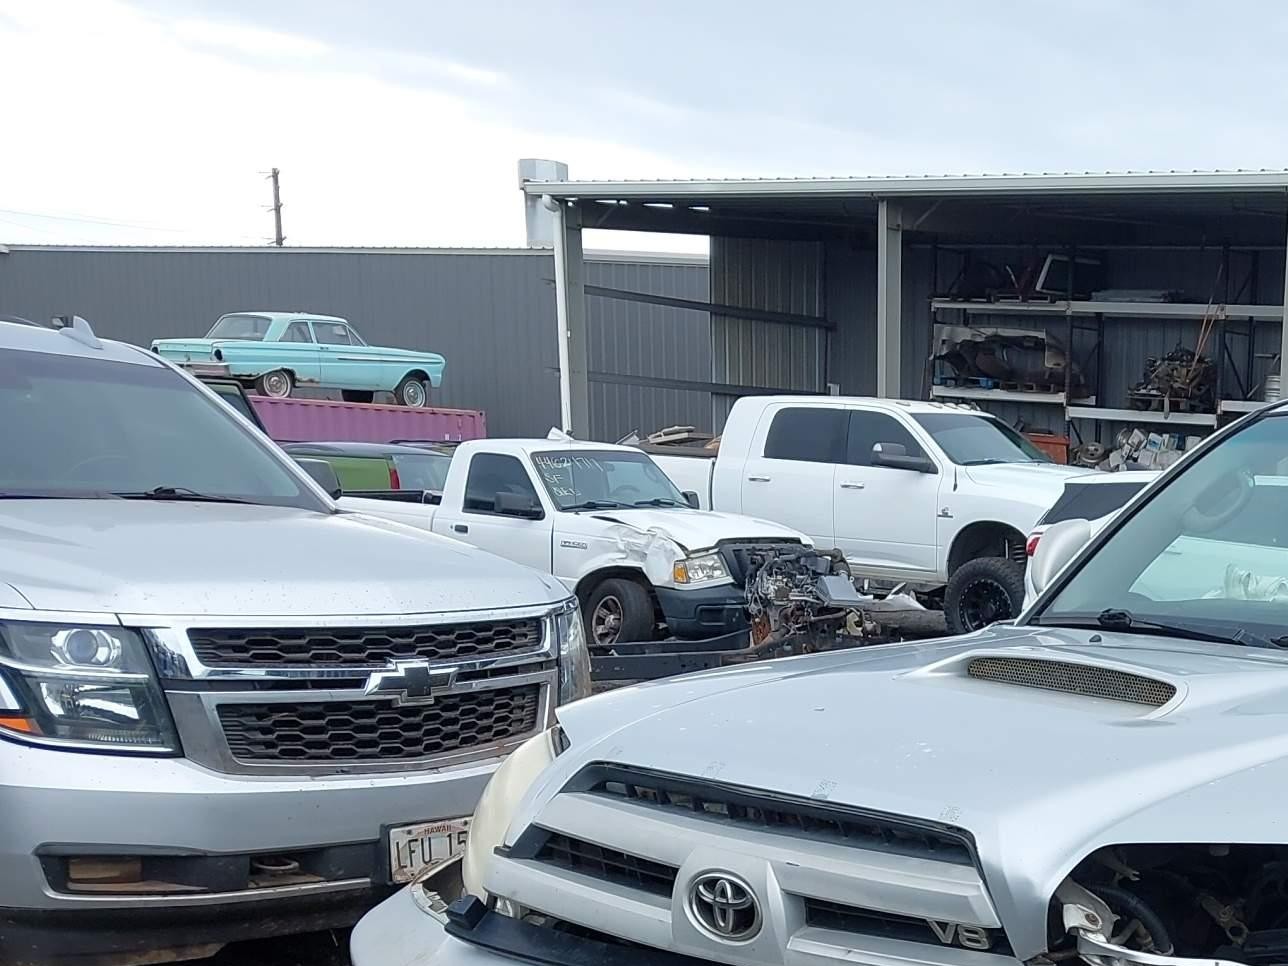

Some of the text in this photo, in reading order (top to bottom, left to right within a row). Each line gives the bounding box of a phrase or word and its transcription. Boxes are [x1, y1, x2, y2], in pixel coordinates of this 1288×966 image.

[424, 824, 452, 836] HAWAII
[395, 837, 432, 869] LFU
[927, 919, 989, 949] V8
